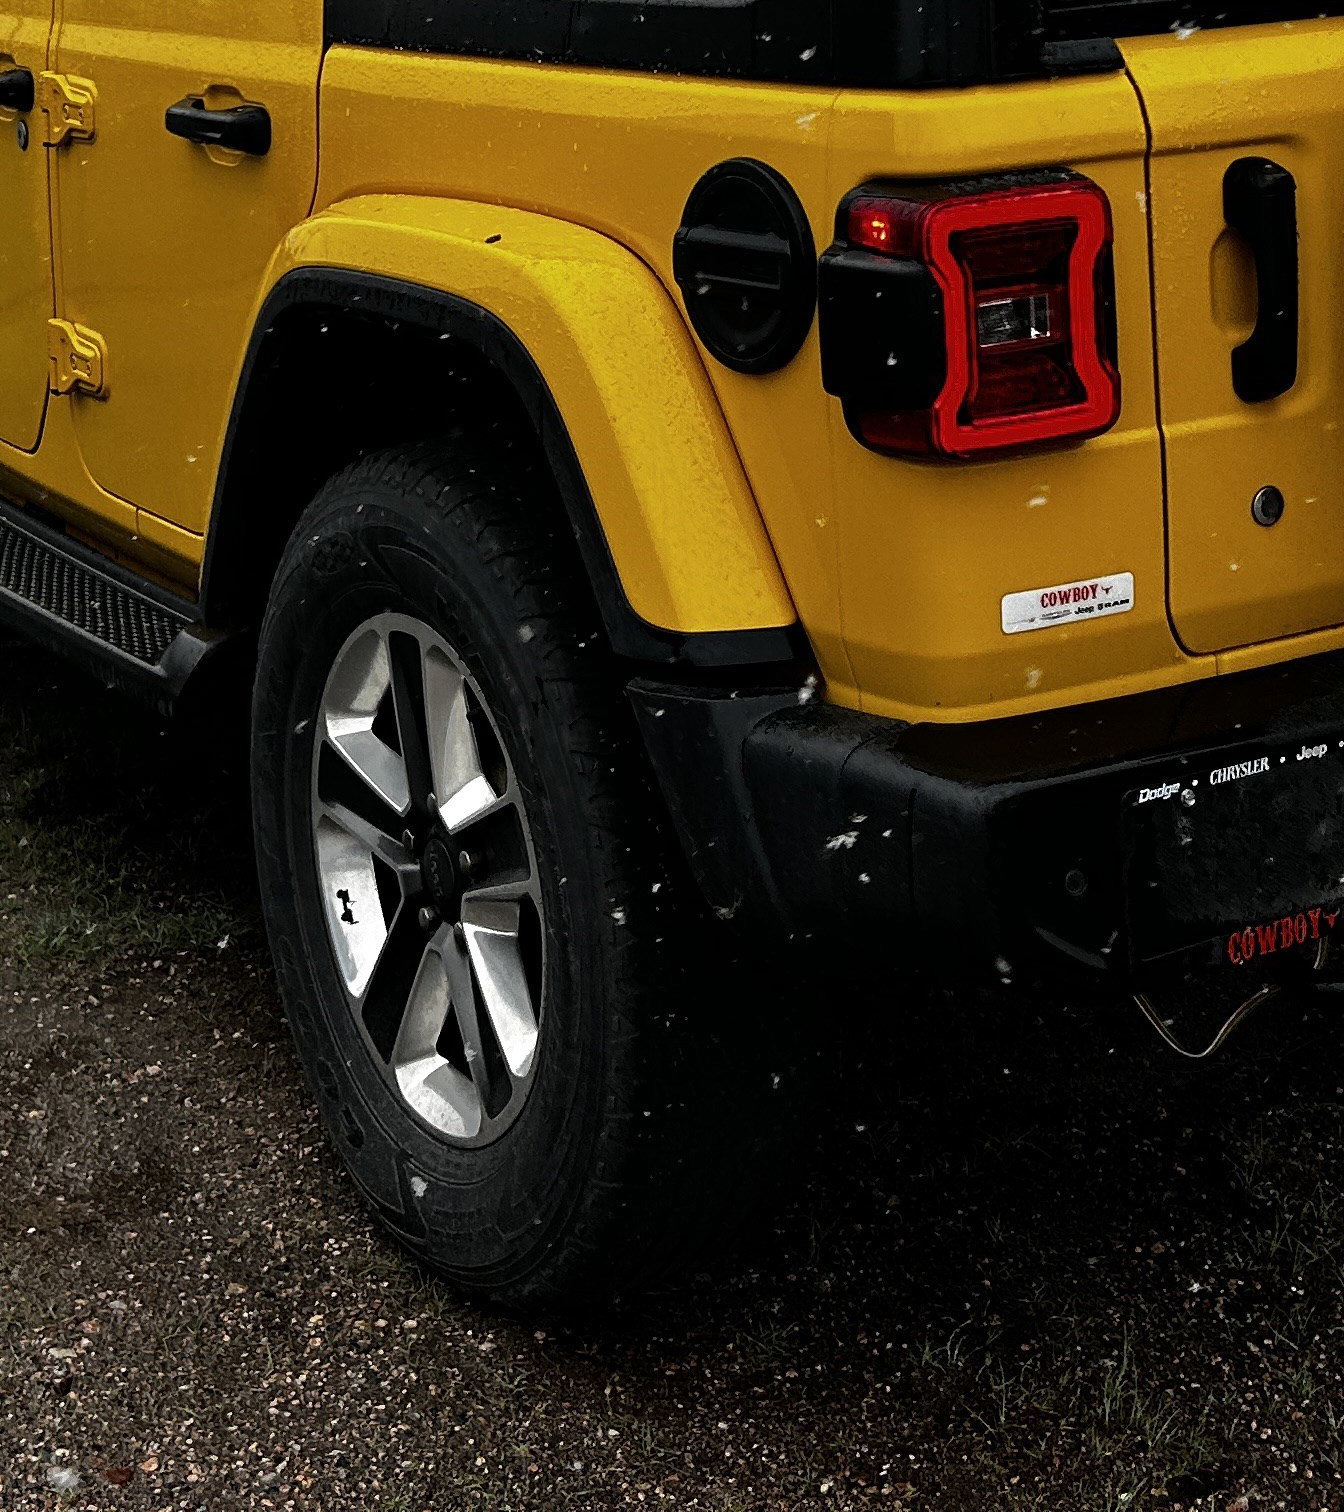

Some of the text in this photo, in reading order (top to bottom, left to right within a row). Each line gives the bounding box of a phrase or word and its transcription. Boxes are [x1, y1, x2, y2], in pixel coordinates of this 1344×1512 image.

[1040, 583, 1099, 608] COWBOY
[1074, 605, 1095, 615] Jeep
[1104, 598, 1130, 608] RAM
[1138, 781, 1181, 804] Dodge
[1209, 756, 1270, 785] CHRYSLER
[1296, 743, 1328, 761] Jeep
[1227, 907, 1322, 965] COWBOY
